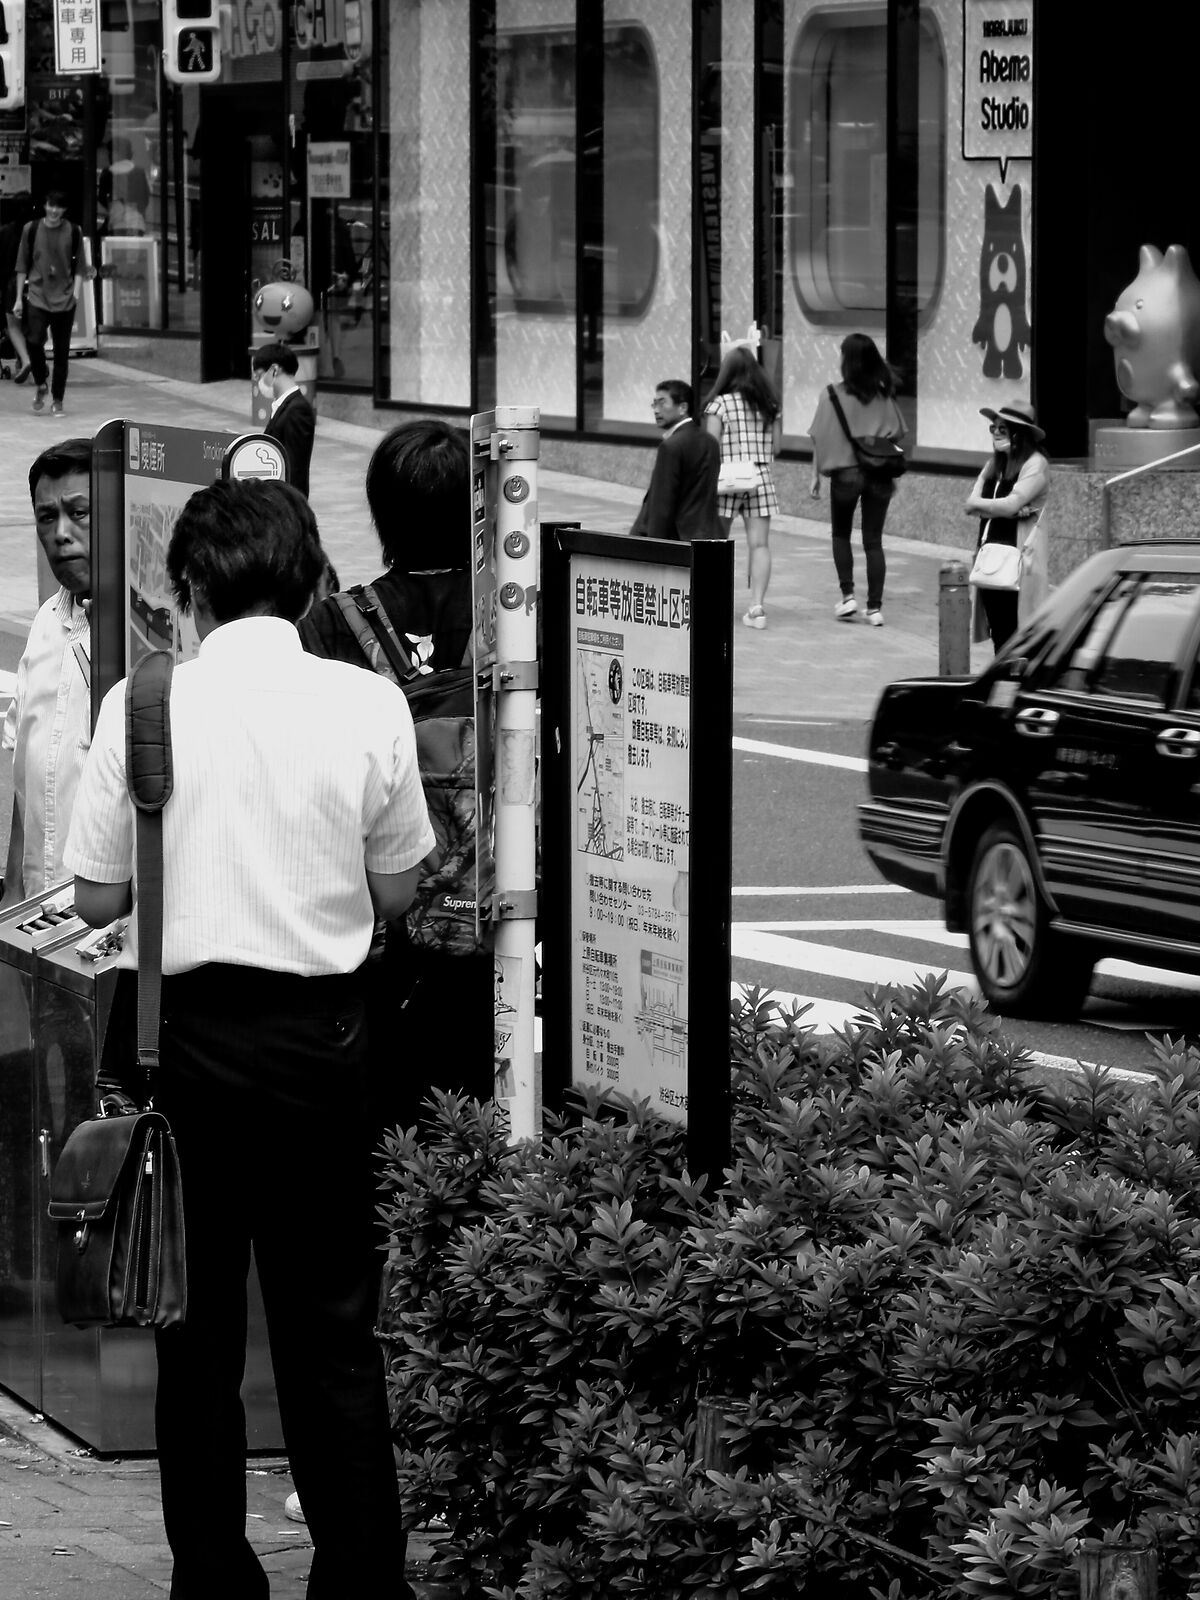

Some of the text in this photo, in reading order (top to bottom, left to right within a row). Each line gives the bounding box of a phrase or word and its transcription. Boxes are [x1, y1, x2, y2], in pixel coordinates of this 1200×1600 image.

[980, 50, 1030, 83] Abema
[981, 96, 1029, 130] Studio
[141, 440, 165, 473] 喫煙所
[576, 574, 690, 631] 自転車等放置禁止区域
